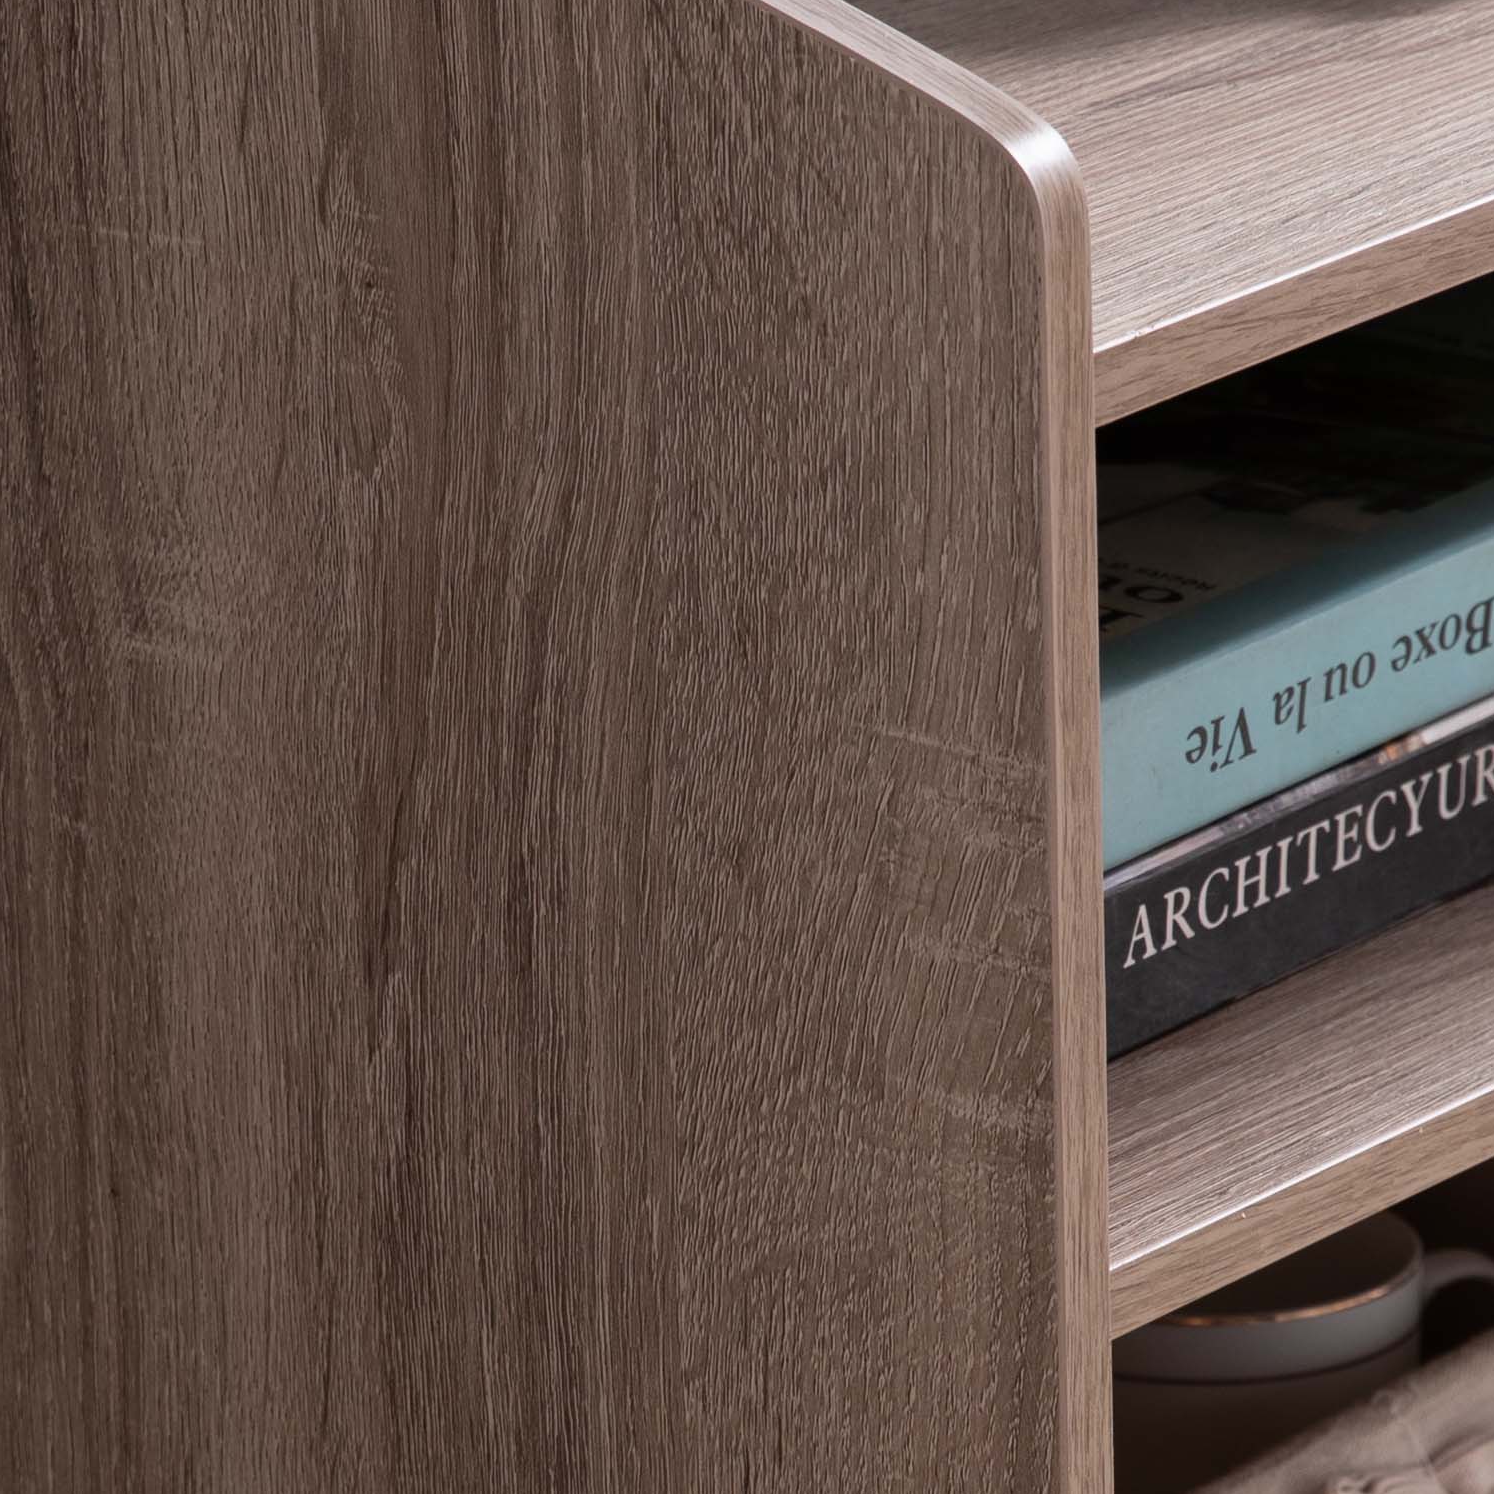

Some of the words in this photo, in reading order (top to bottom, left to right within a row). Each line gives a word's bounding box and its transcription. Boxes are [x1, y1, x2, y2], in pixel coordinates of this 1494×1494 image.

[1273, 677, 1311, 733] la
[1323, 652, 1376, 702] ou
[1185, 707, 1256, 772] Vie
